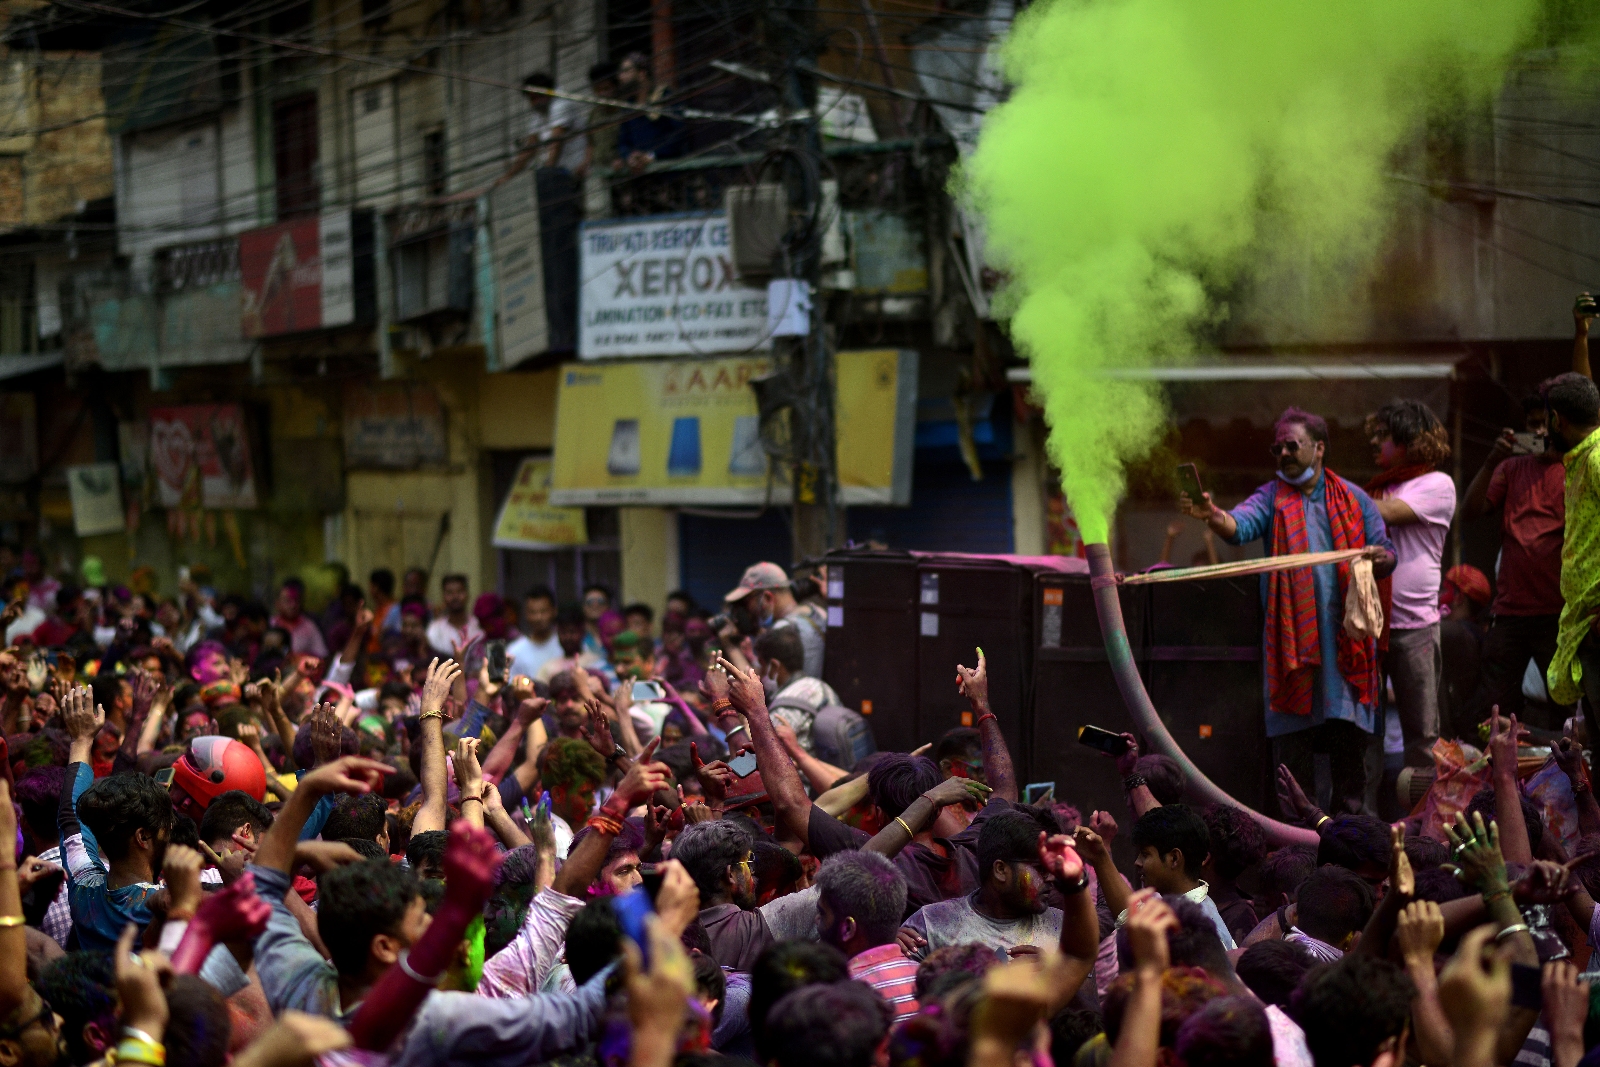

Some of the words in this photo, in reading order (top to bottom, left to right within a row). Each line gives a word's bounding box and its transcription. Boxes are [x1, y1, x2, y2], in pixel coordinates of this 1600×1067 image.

[652, 225, 704, 250] XEROX
[613, 254, 734, 299] XEROX
[588, 306, 665, 327] LAMINATION
